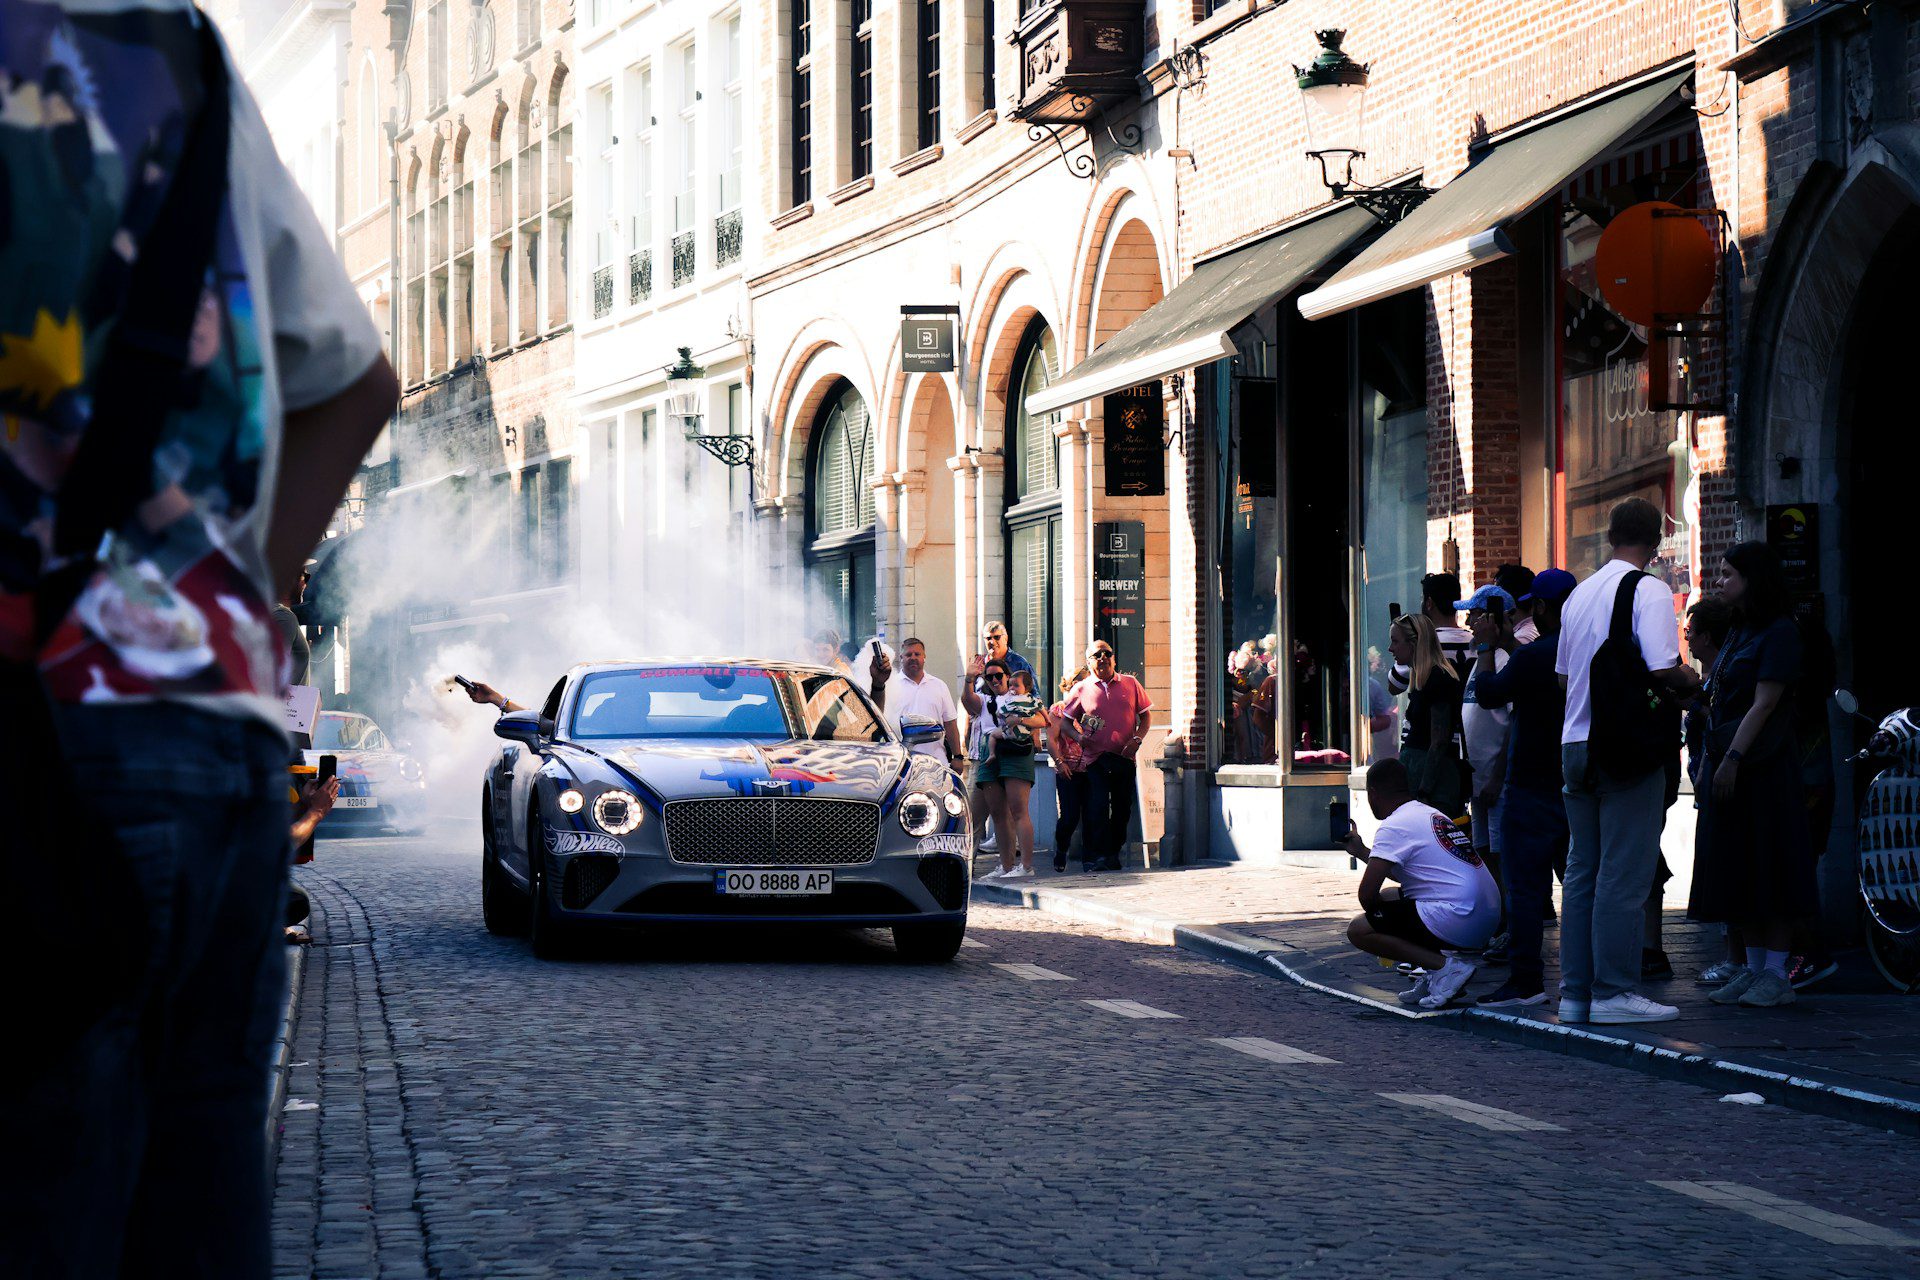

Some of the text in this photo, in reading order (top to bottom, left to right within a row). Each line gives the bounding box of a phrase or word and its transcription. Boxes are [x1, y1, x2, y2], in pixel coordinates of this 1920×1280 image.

[1099, 579, 1140, 591] BREWERY
[1111, 617, 1120, 626] 50
[639, 667, 732, 679] GUMBALL
[728, 873, 755, 891] OO
[760, 873, 800, 891] 8888
[804, 873, 831, 891] AP
